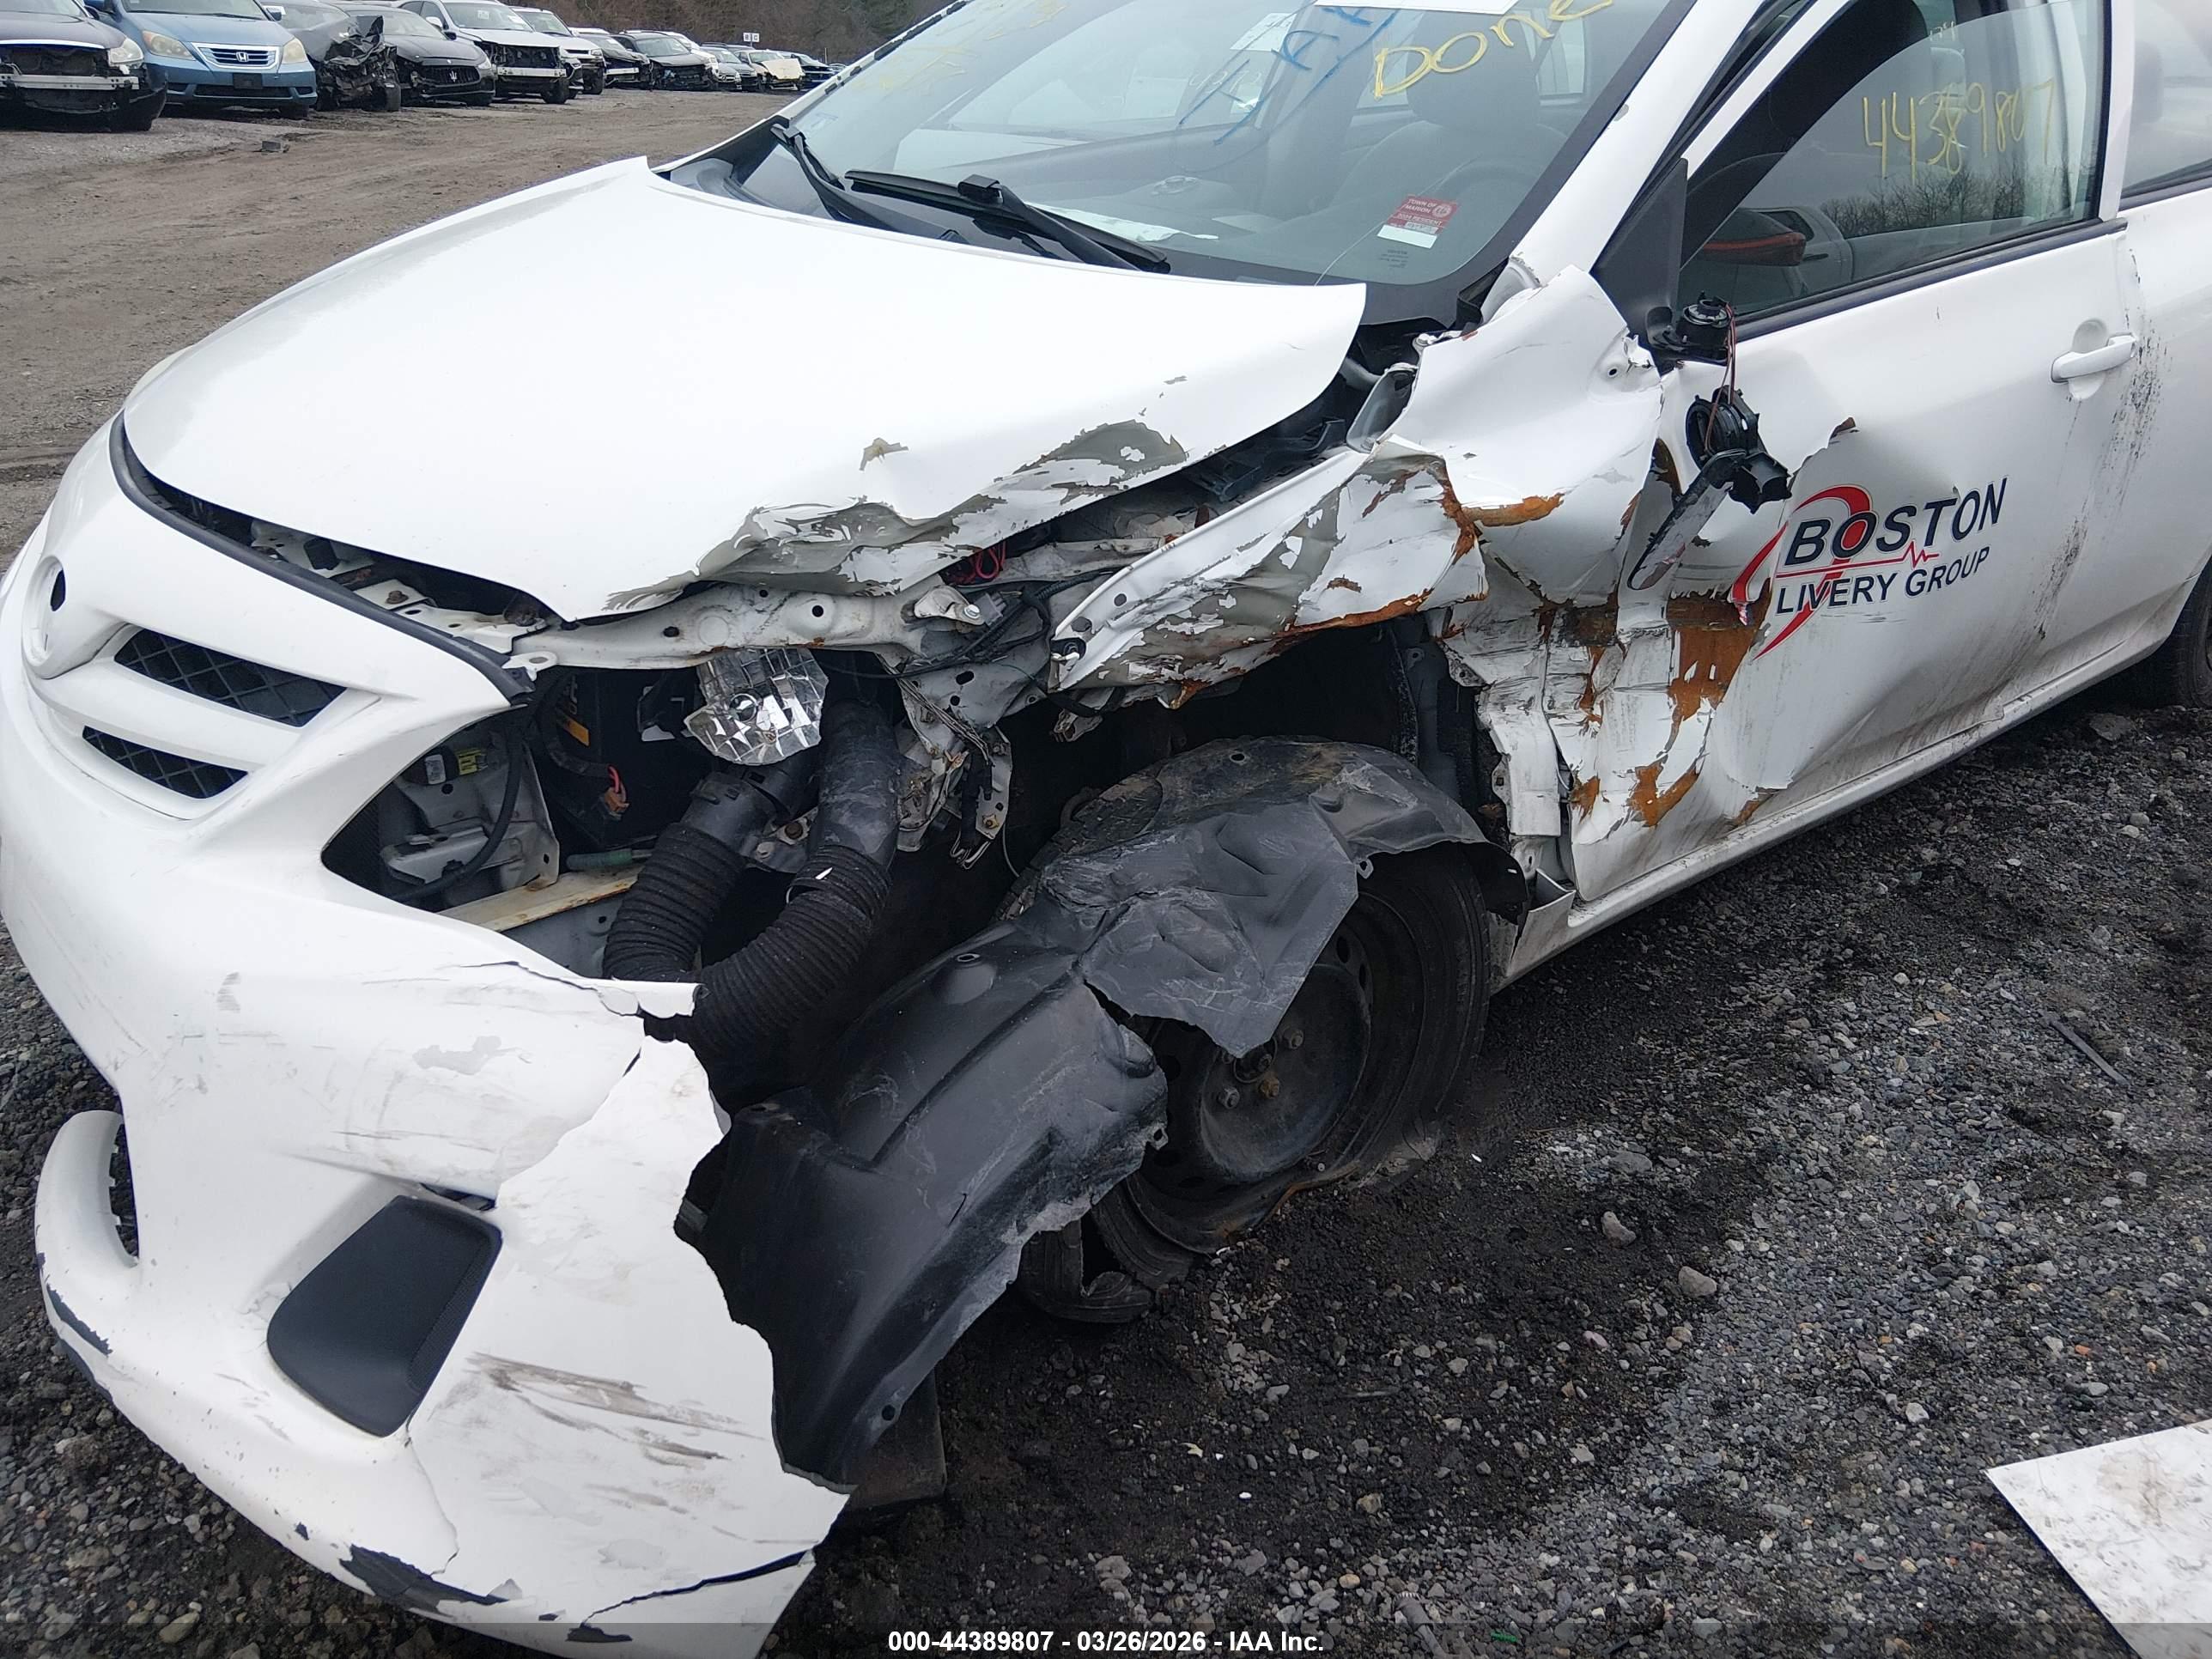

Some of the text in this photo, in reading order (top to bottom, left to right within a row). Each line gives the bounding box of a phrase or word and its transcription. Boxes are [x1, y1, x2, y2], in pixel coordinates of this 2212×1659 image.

[1408, 198, 1428, 207] TOWN
[1784, 477, 2008, 567] BOSTON
[1776, 546, 1990, 615] LIVERY GROUP
